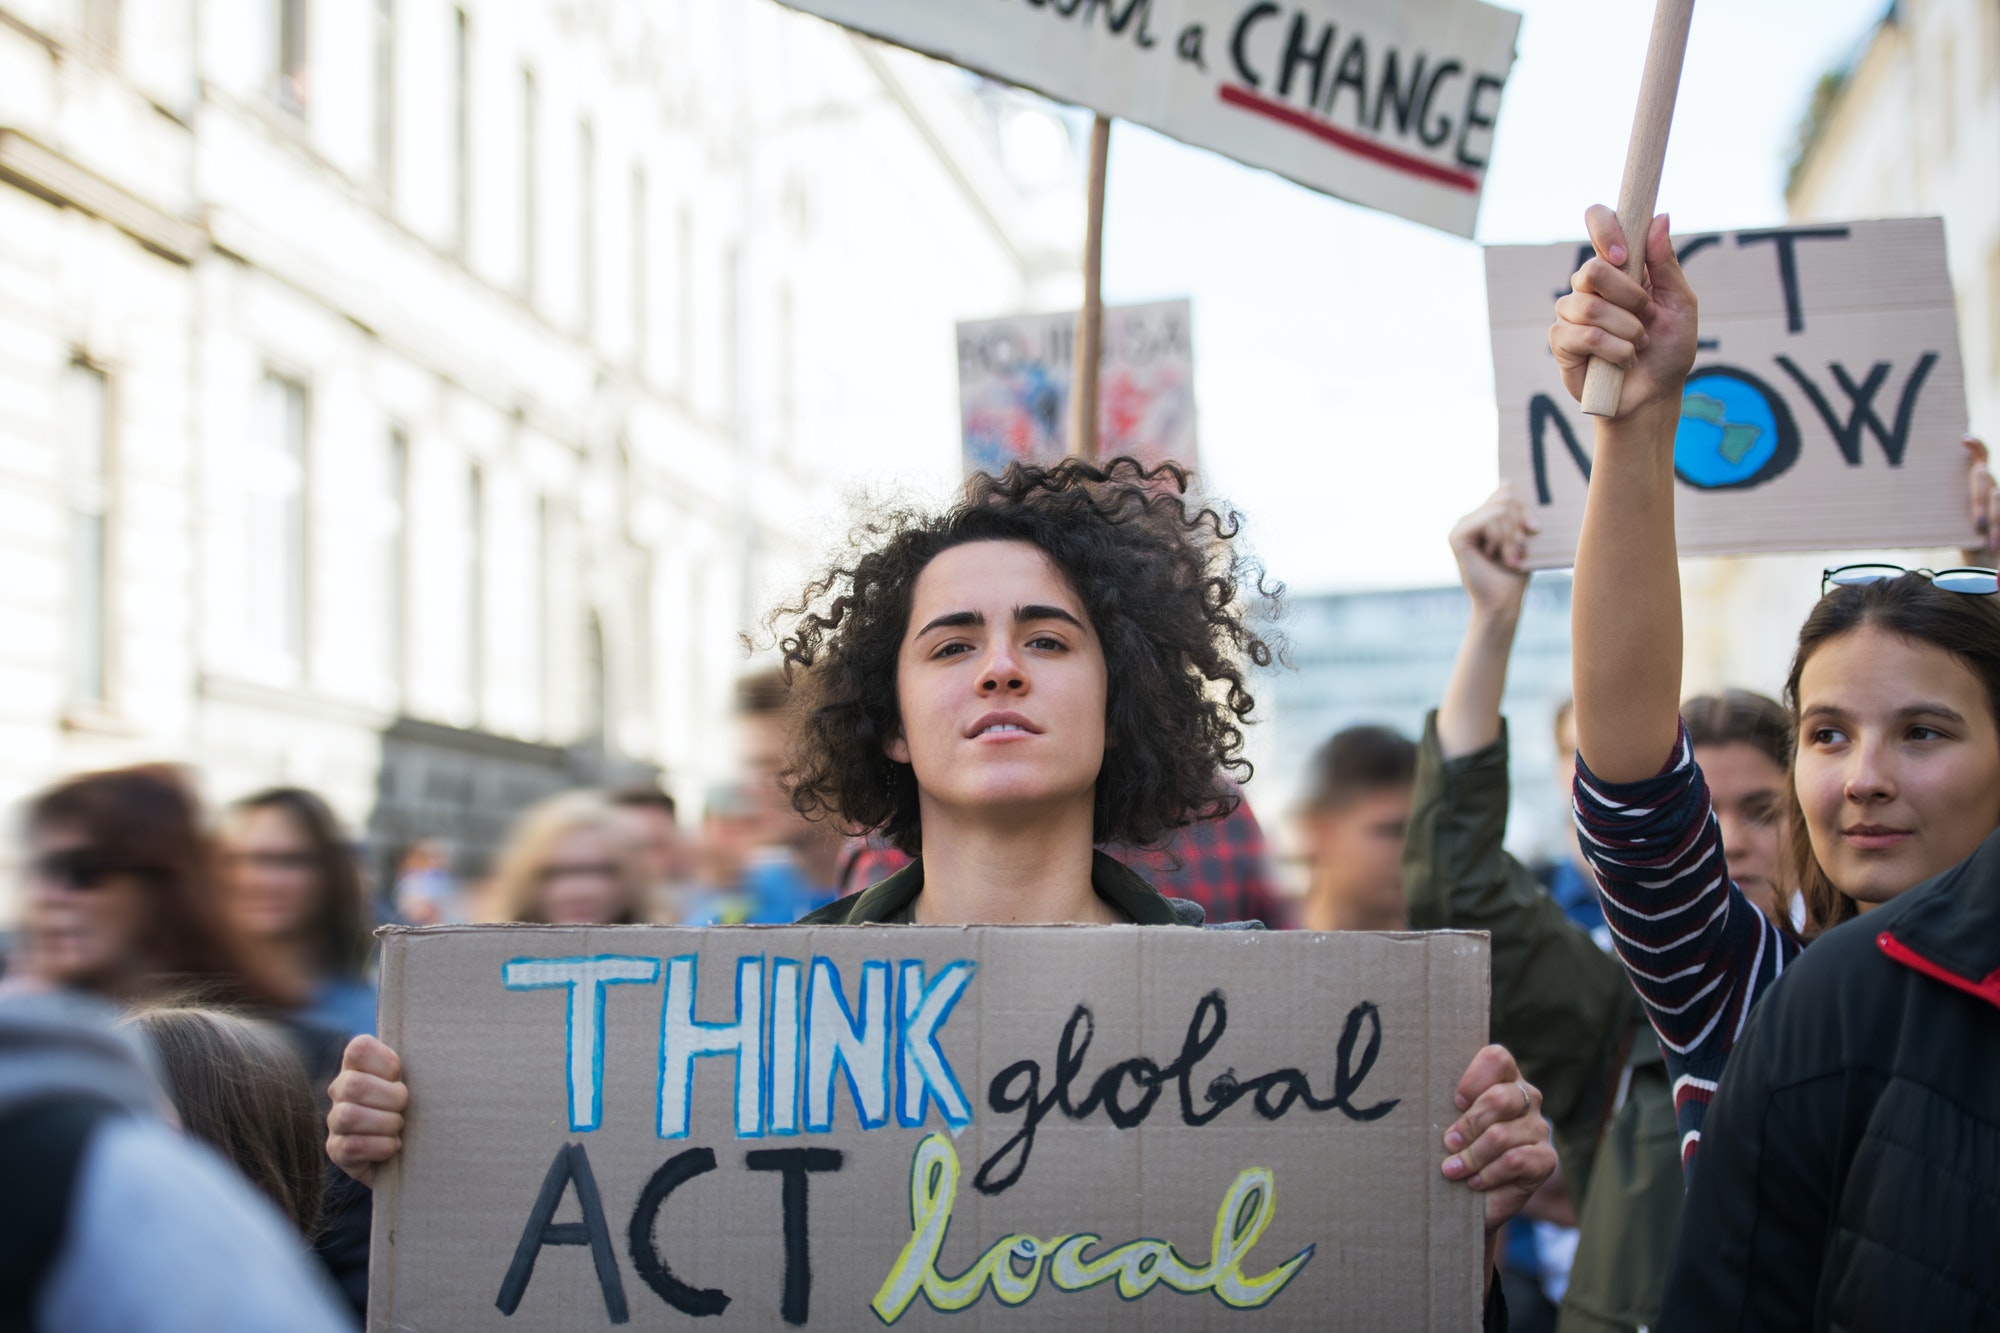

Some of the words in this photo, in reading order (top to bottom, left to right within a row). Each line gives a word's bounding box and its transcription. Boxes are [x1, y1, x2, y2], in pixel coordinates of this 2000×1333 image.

[1229, 1, 1504, 168] CHANGE
[502, 949, 979, 1140] THINK
[973, 987, 1402, 1196] global
[494, 1141, 846, 1326] ACT
[869, 1132, 1317, 1327] local
